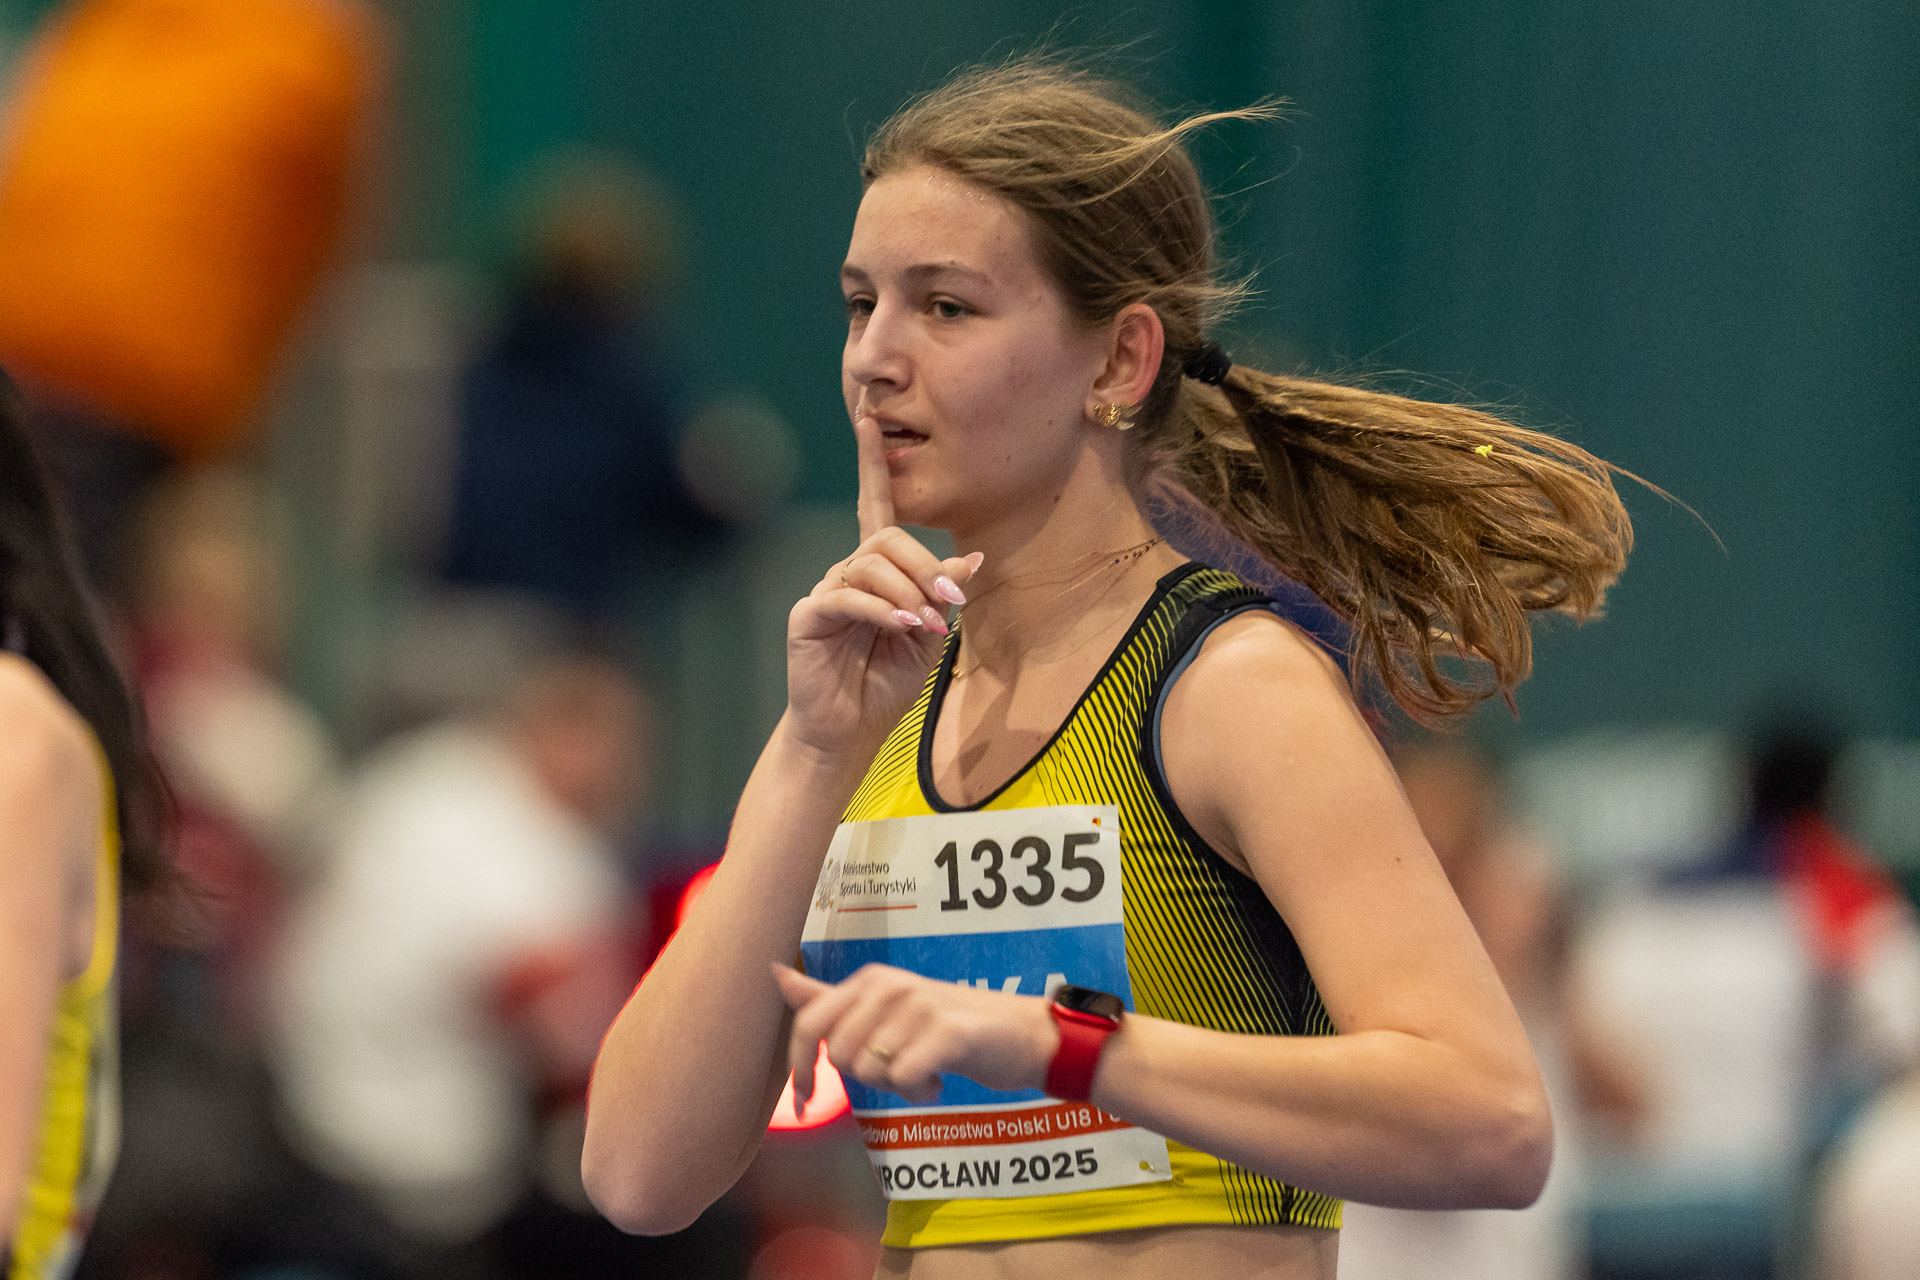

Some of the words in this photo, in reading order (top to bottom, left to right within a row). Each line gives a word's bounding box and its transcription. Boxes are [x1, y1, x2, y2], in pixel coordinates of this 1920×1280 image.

[842, 861, 889, 876] Ministerstwo
[934, 832, 1106, 911] 1335
[839, 881, 861, 898] Sportu
[868, 877, 917, 896] Turystyki
[903, 1121, 993, 1142] Mistrzostwa
[997, 1113, 1050, 1137] Polski
[1056, 1108, 1092, 1131] U18
[879, 1160, 1000, 1191] ROCŁAW
[1009, 1148, 1099, 1184] 2025
